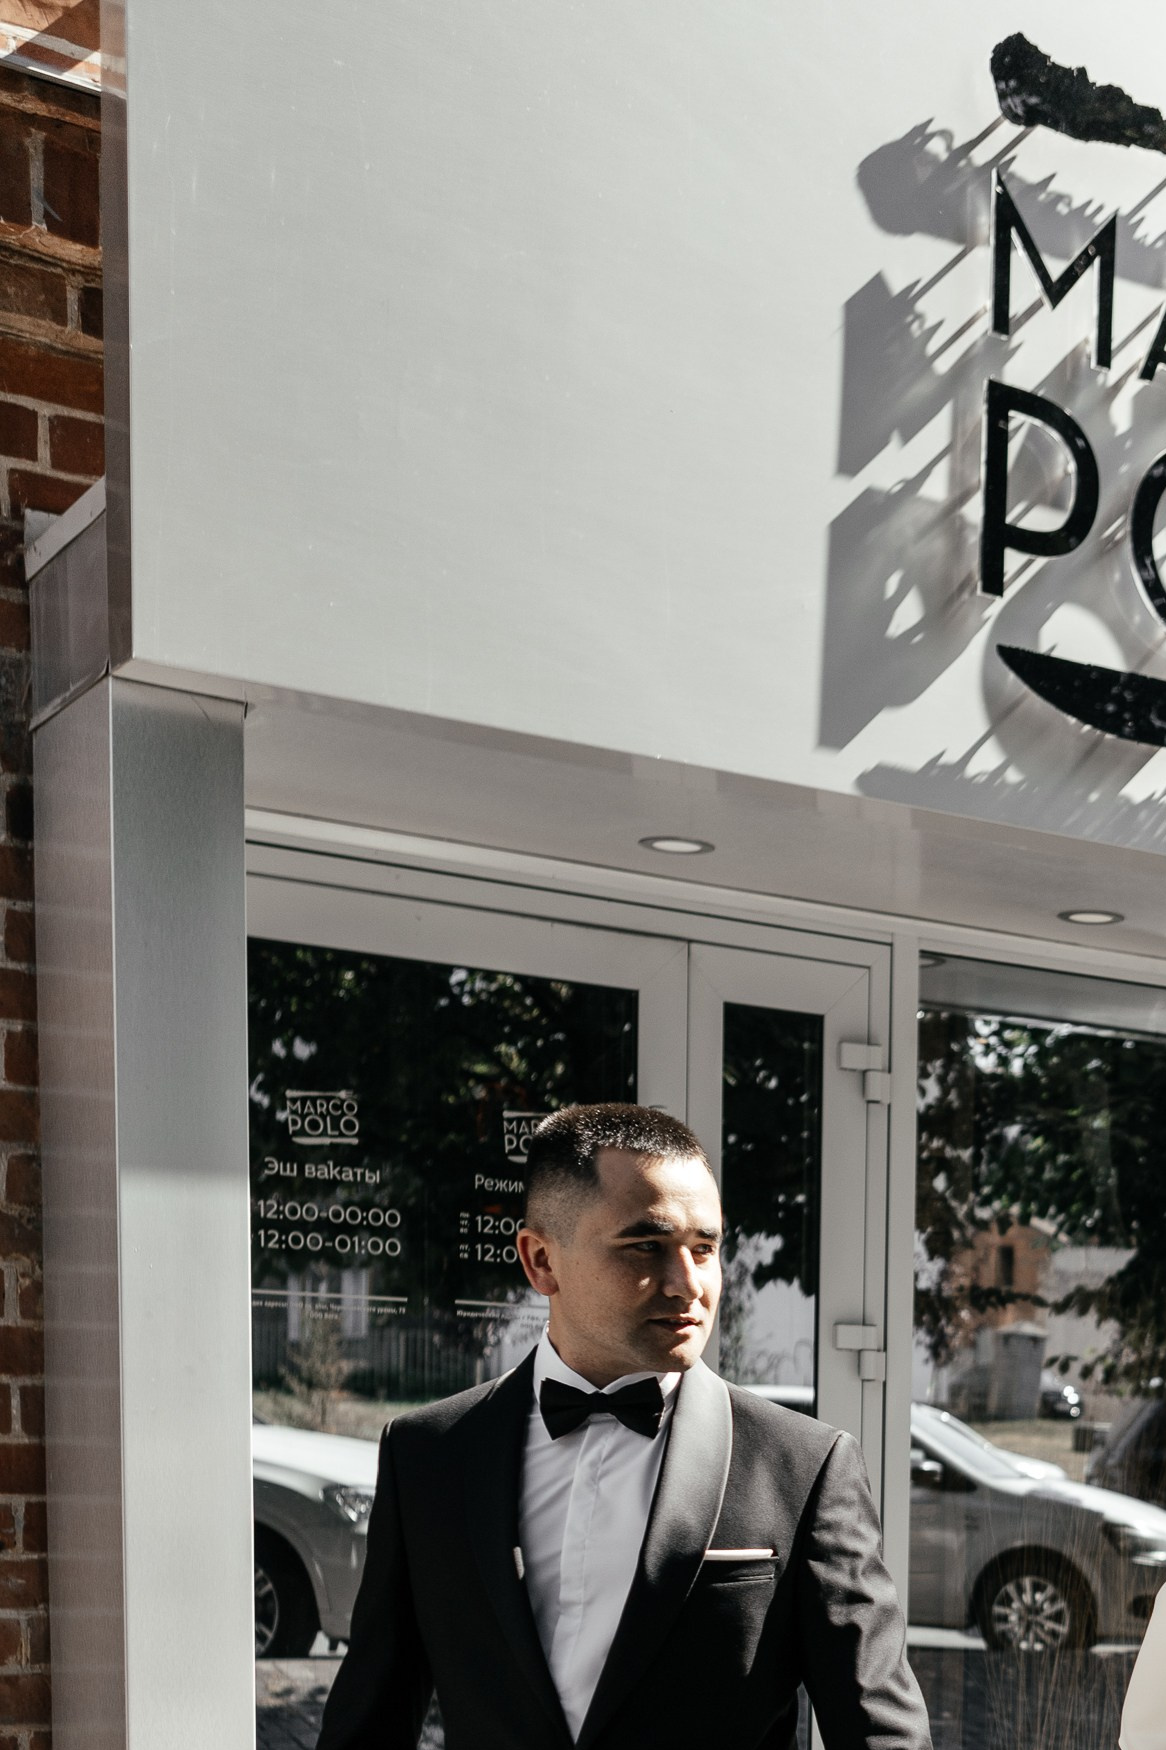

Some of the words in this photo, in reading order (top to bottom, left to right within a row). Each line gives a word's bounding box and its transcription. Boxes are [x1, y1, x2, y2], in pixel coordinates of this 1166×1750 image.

[286, 1100, 358, 1116] MARCO
[288, 1115, 360, 1136] POLO
[264, 1156, 297, 1178] Эш
[257, 1199, 401, 1229] 12:00-00:00
[258, 1229, 402, 1257] 12:00-01:00
